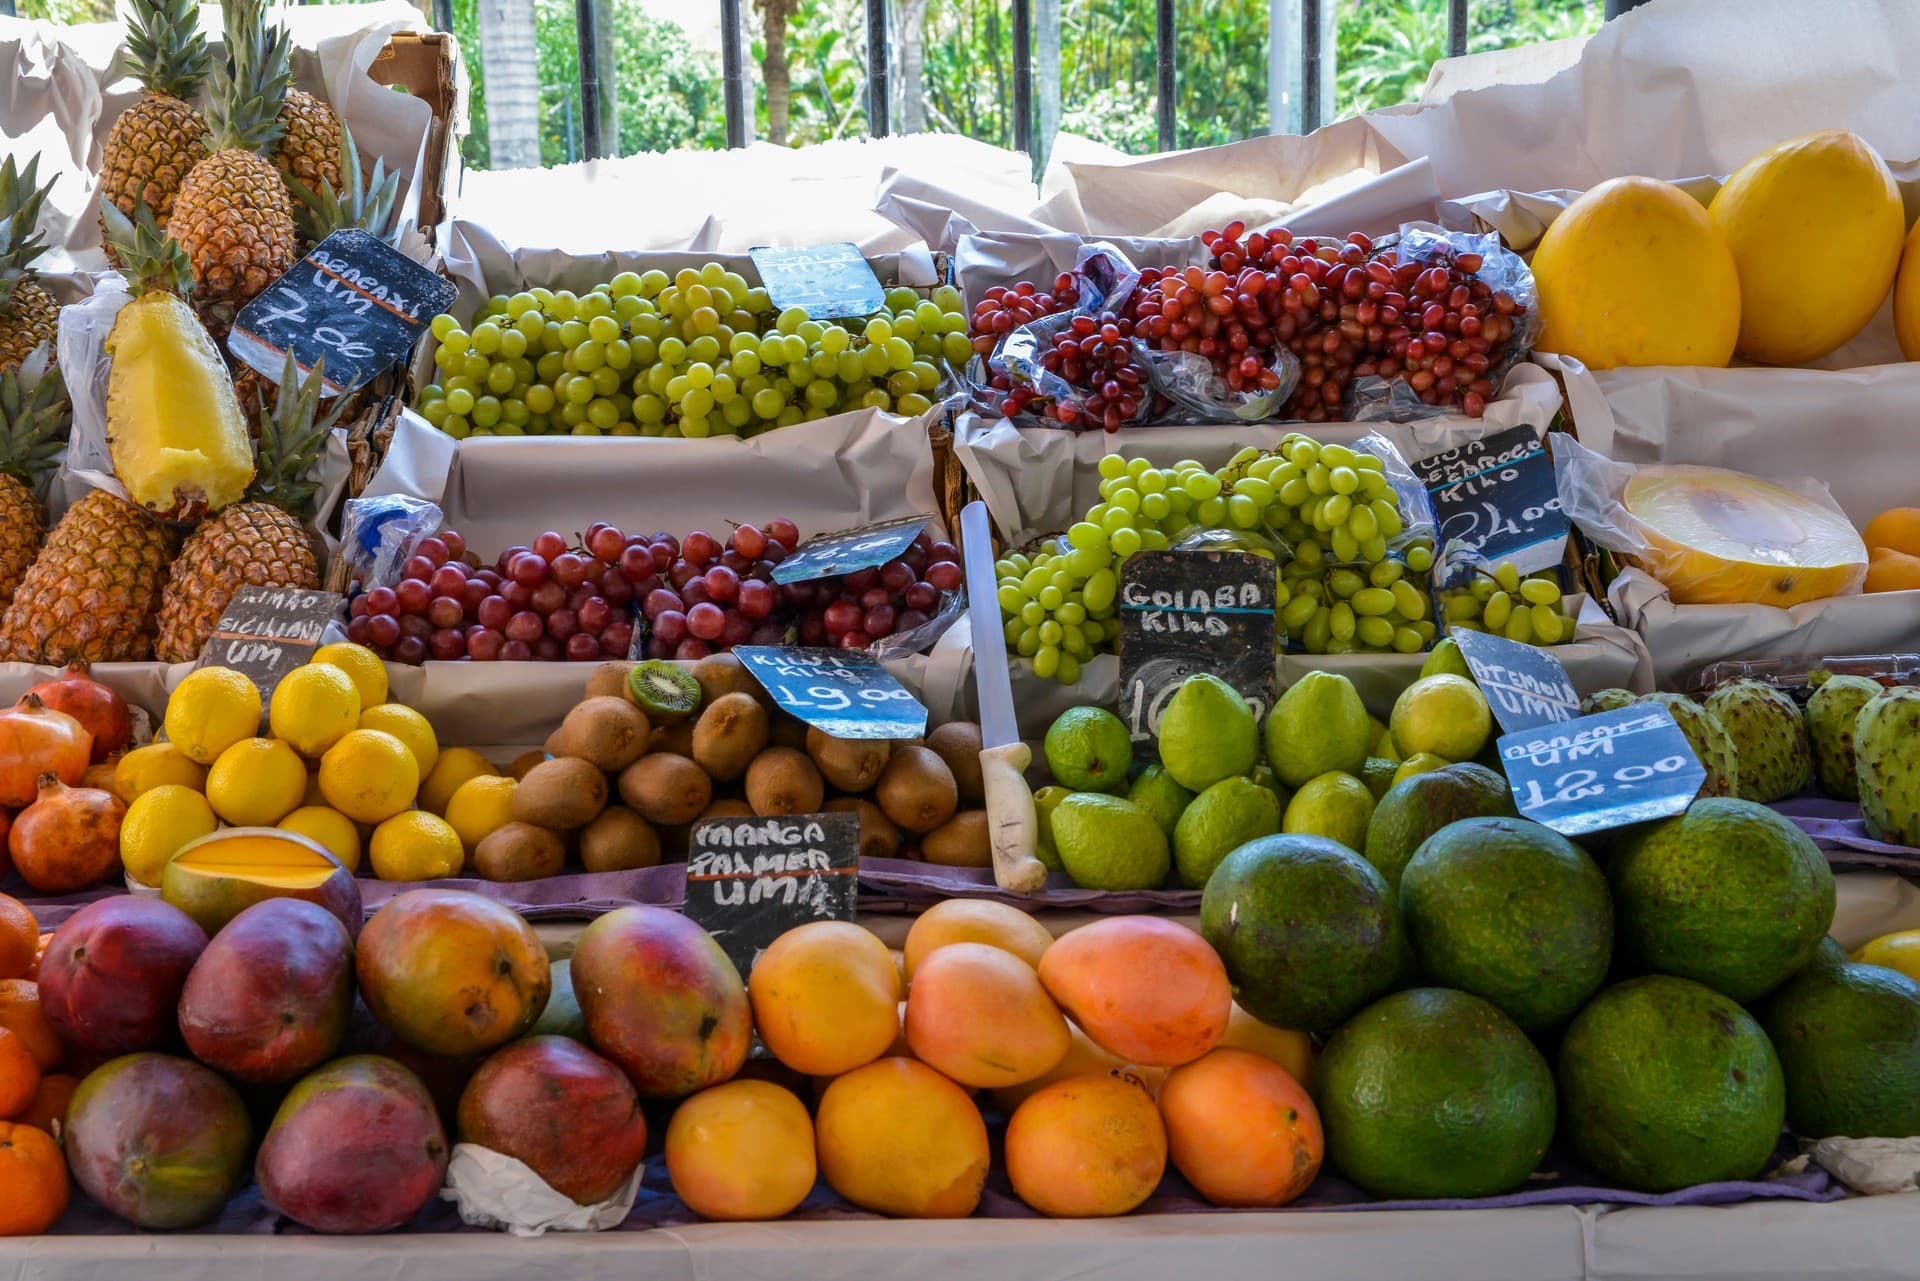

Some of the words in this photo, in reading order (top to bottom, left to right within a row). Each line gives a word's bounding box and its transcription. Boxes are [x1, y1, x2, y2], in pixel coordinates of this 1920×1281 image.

[312, 269, 375, 316] UM
[255, 286, 376, 358] 7.00
[1440, 468, 1520, 503] KILO
[1122, 581, 1262, 614] GOIABA
[1140, 609, 1231, 637] KILO
[226, 639, 283, 671] UM
[751, 654, 845, 668] KIWI
[775, 665, 854, 679] KILO
[1468, 655, 1582, 710] ATEMOIA
[776, 684, 913, 711] 19.00
[1493, 683, 1572, 723] UMA
[1530, 738, 1615, 766] UM
[1520, 755, 1688, 811] 12.00
[695, 819, 826, 848] MANGA
[686, 848, 832, 878] PALMER
